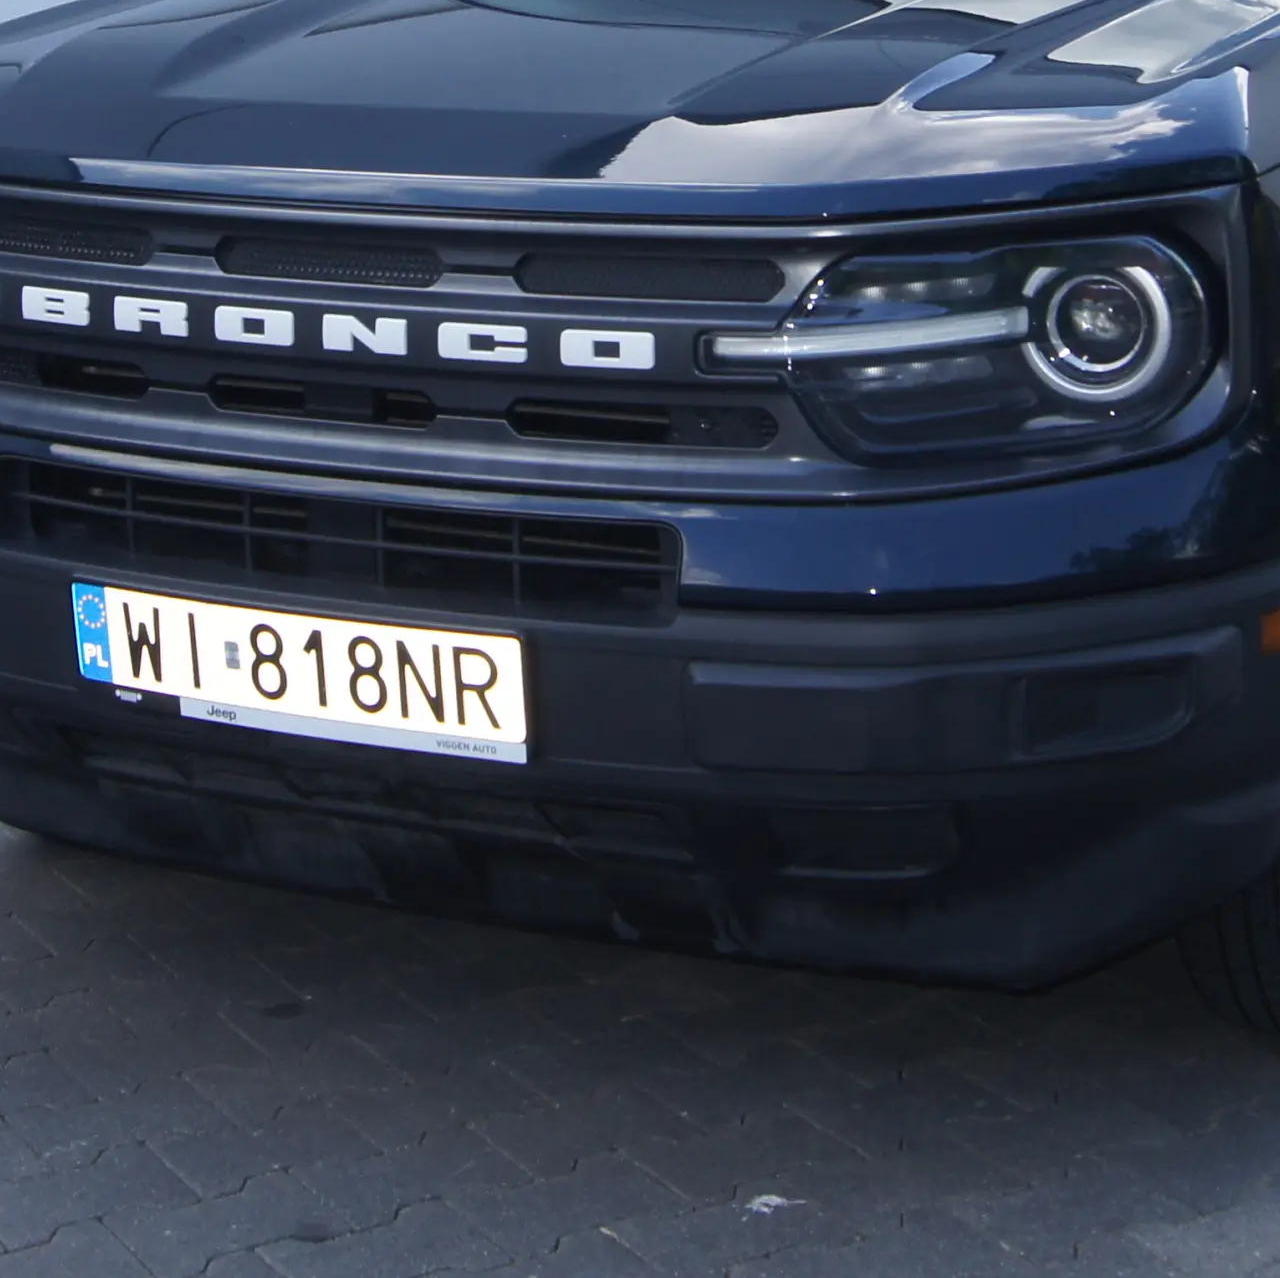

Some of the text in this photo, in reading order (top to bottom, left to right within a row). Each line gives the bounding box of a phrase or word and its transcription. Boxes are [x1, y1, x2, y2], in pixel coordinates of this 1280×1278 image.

[21, 284, 656, 370] BRONCO
[82, 642, 109, 669] PL
[122, 602, 501, 730] WI 818NR
[206, 705, 237, 722] Jeep
[472, 744, 497, 755] AUTO
